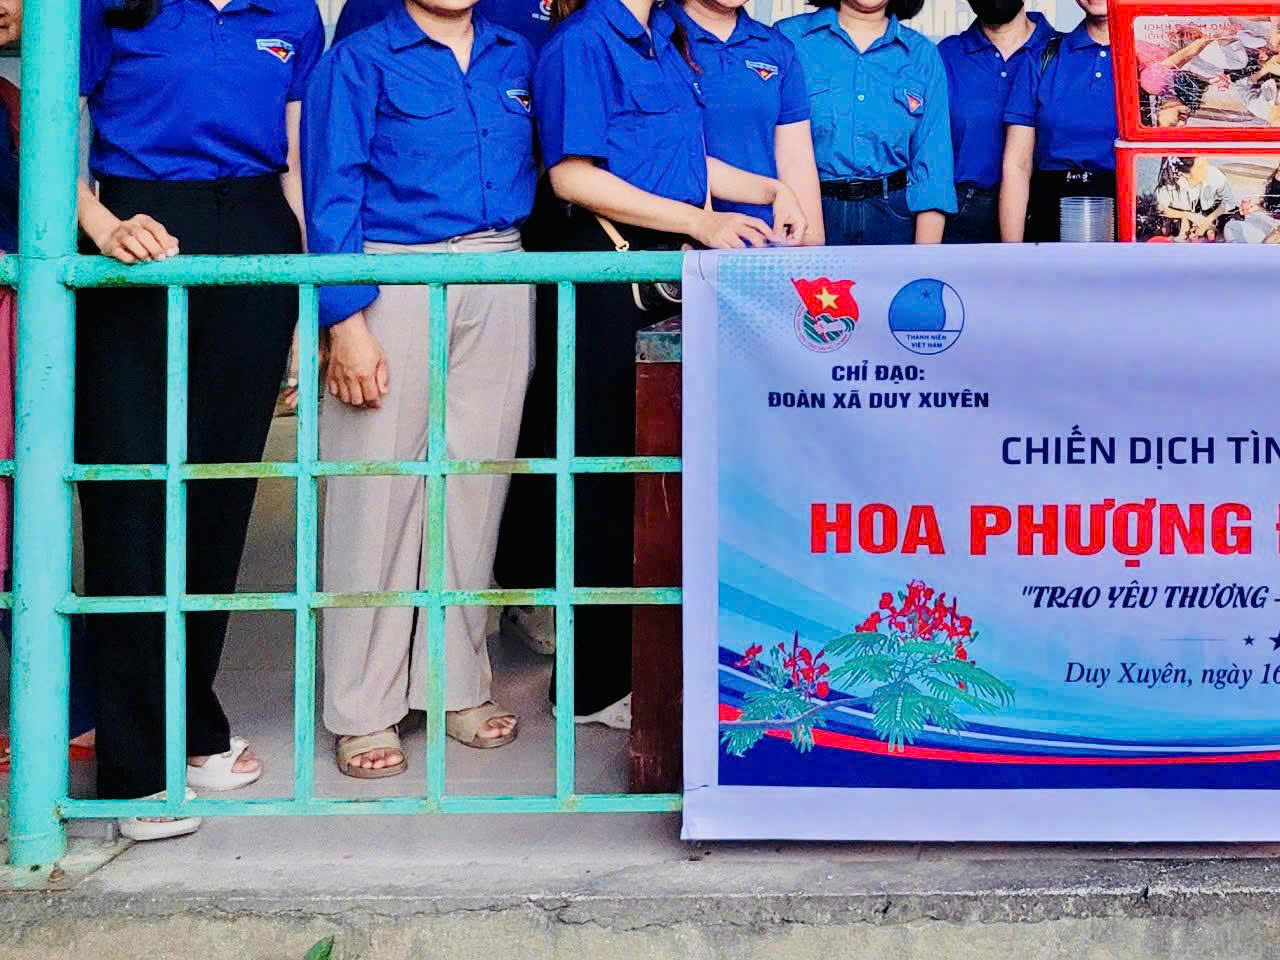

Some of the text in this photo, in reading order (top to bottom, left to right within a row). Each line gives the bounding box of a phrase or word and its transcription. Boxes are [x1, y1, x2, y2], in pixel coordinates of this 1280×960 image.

[906, 333, 947, 341] THANH NIÊN
[832, 360, 924, 384] CHỈ ĐẠO:
[768, 389, 988, 408] ĐOÀN XÃ DUY XUYÊN
[1002, 424, 1115, 464] CHIẾN
[1130, 437, 1214, 469] DỊCH
[811, 503, 945, 555] HOA
[970, 498, 1252, 567] PHƯỢNG
[1023, 586, 1100, 608] "TRAO
[1108, 580, 1157, 608] YÊU
[1164, 583, 1269, 608] THƯƠNG
[1064, 662, 1110, 688] Duy
[1118, 662, 1192, 688] Xuyên,
[1202, 663, 1252, 689] ngày
